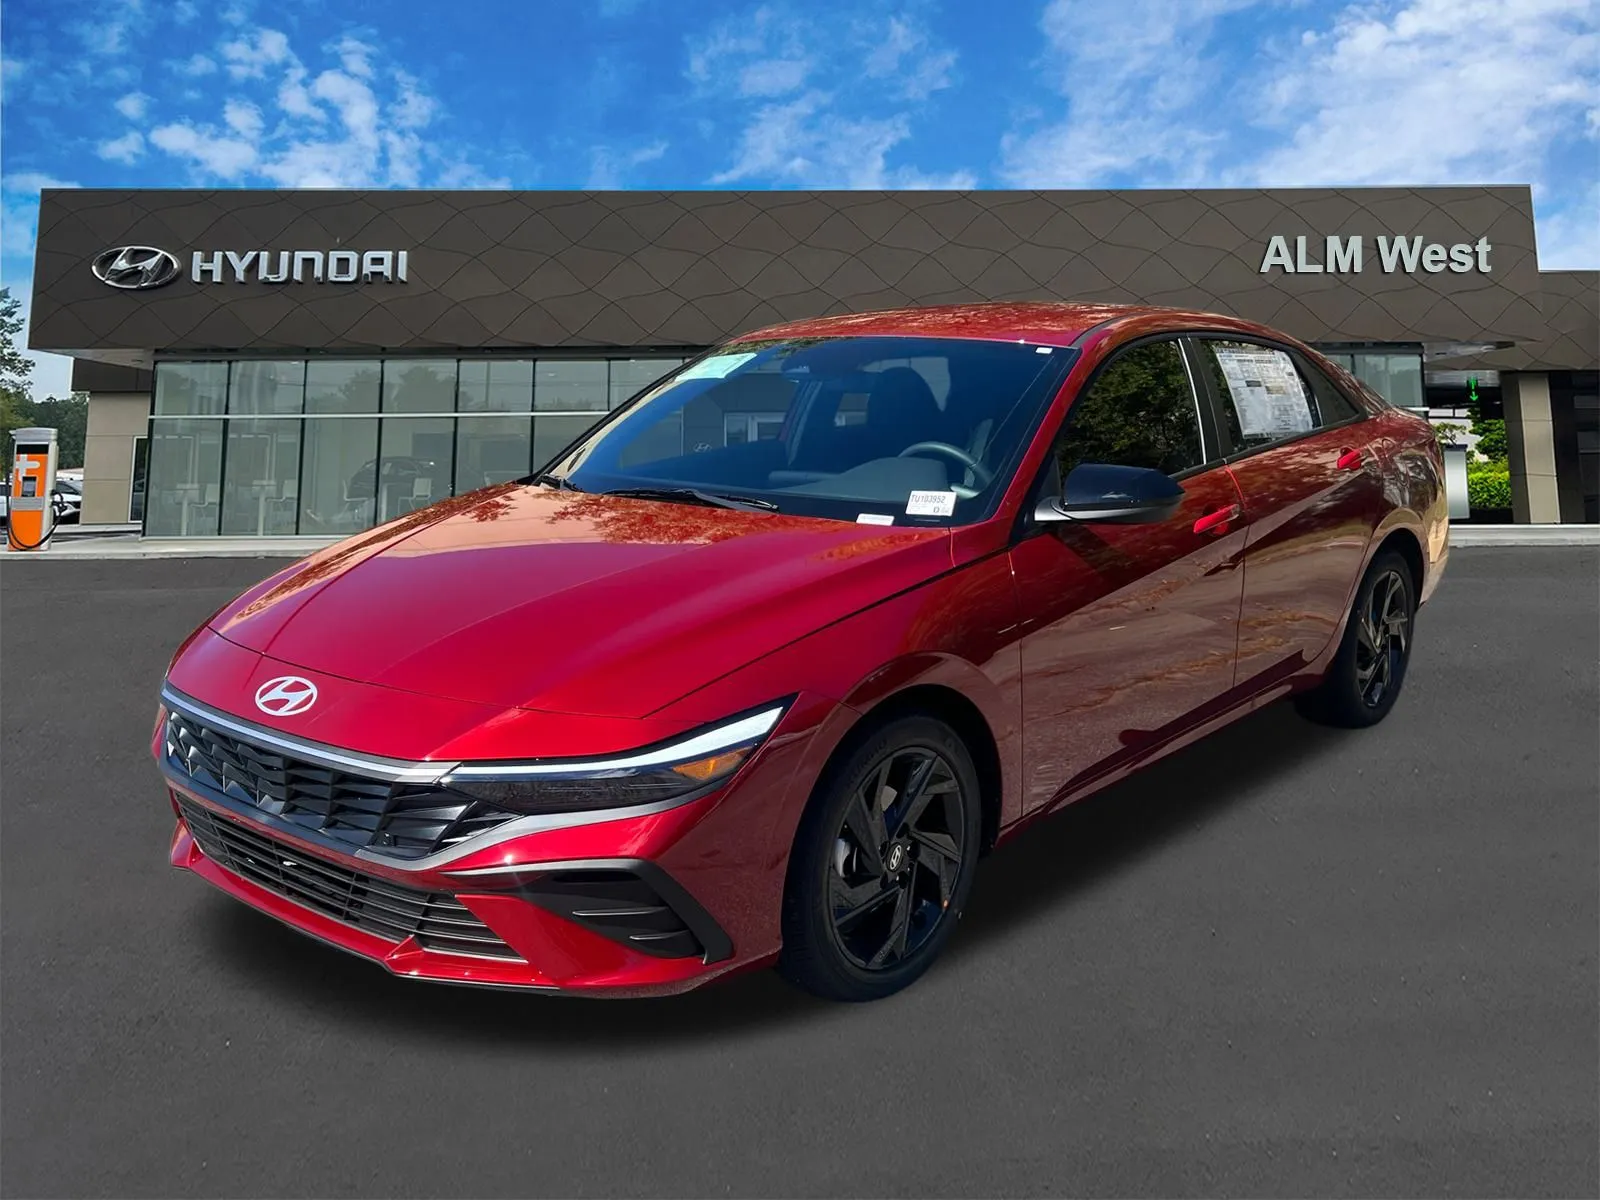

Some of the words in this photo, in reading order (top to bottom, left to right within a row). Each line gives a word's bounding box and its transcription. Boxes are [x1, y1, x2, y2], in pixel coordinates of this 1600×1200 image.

[191, 250, 408, 283] HYUNDAI
[1260, 235, 1363, 273] ALM
[1377, 235, 1492, 273] West
